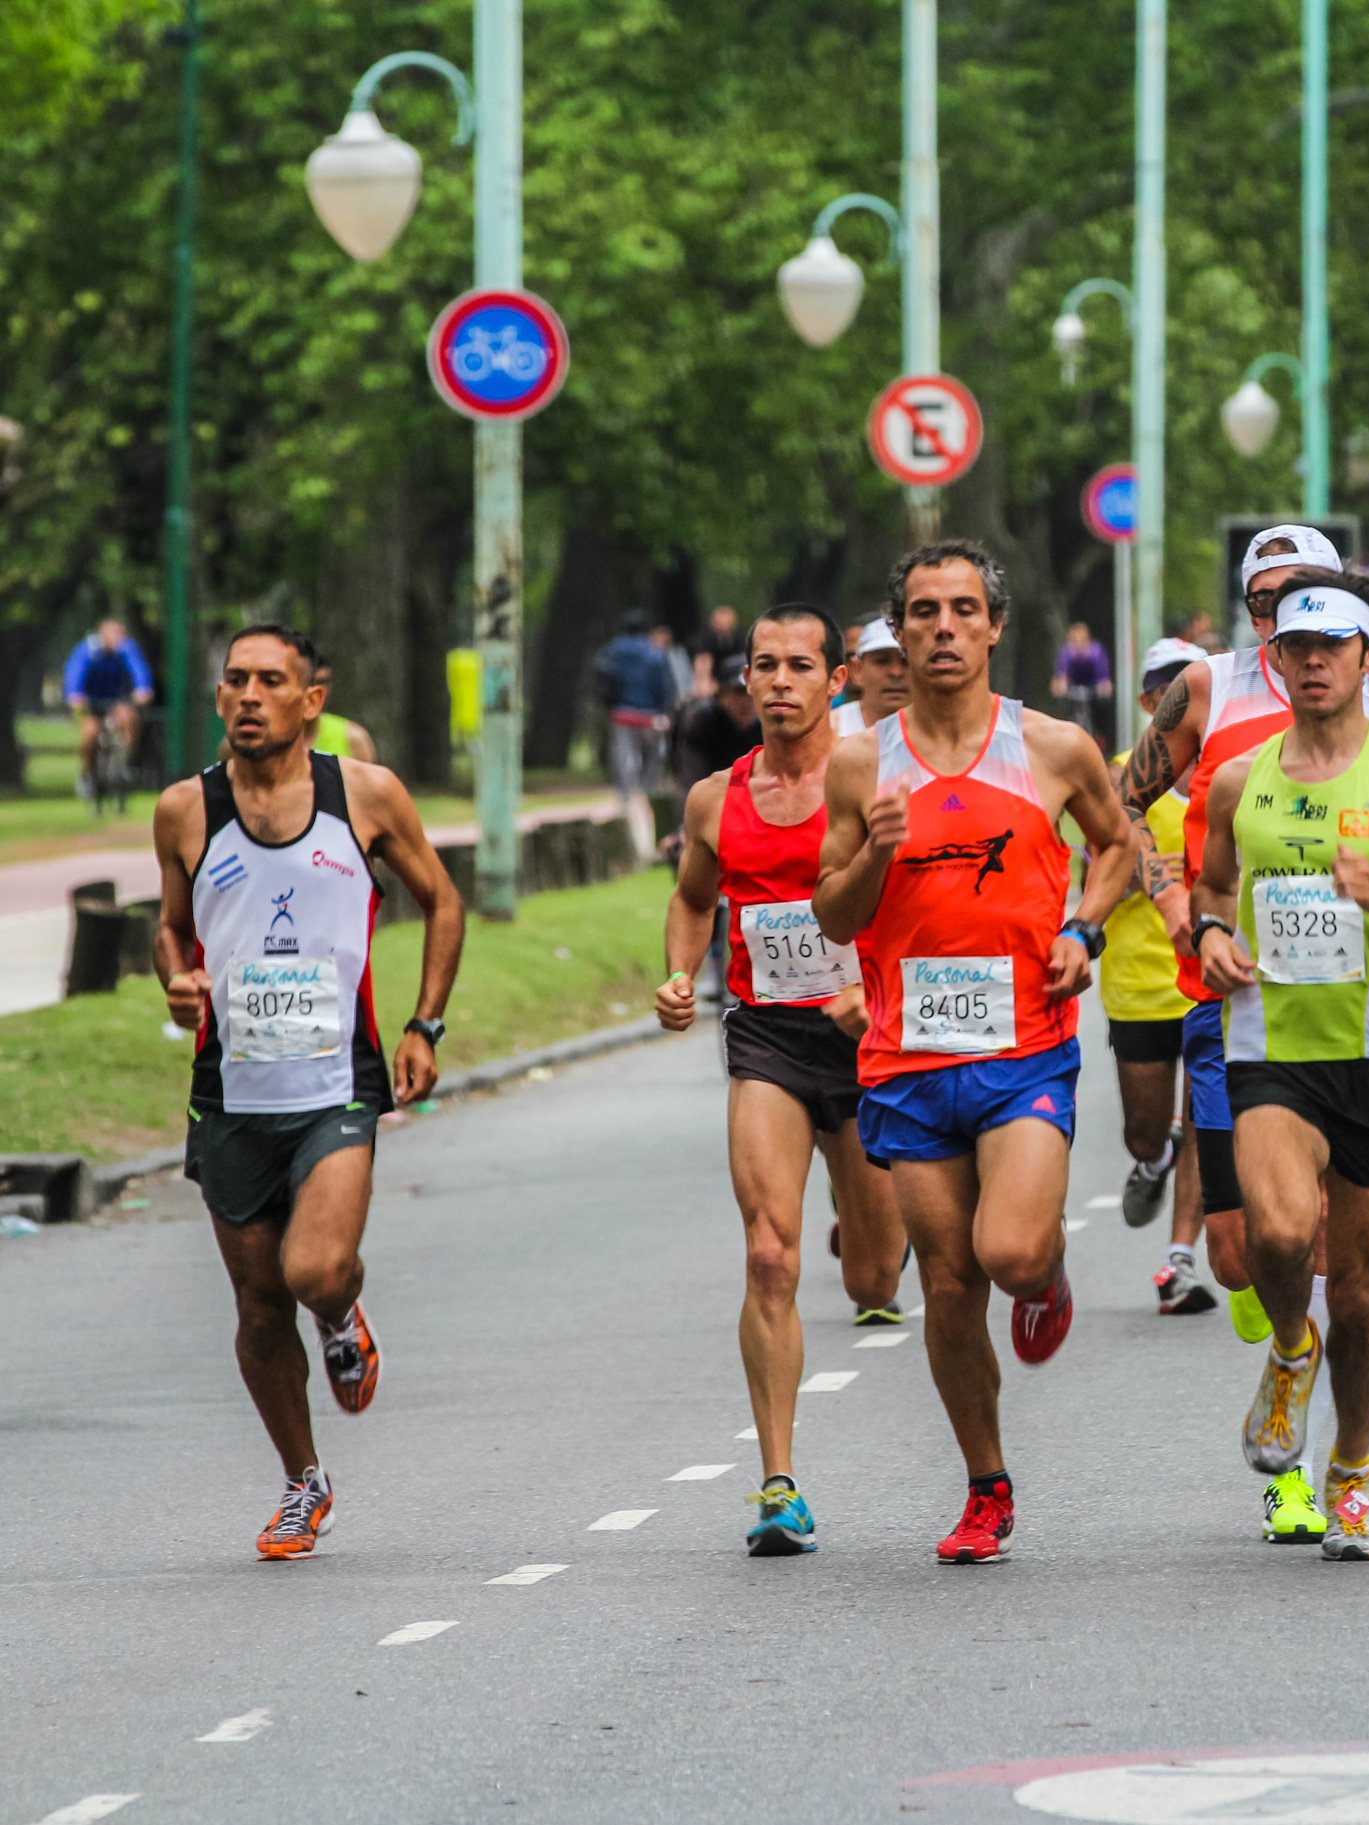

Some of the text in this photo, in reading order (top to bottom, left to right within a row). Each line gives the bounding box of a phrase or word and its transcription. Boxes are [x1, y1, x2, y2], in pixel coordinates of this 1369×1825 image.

[1266, 881, 1338, 906] Persona
[1271, 910, 1338, 938] 5328
[763, 932, 827, 960] 5161
[243, 963, 320, 988] Personal
[915, 961, 995, 984] Personal
[247, 991, 313, 1018] 8075
[920, 993, 988, 1020] 8405
